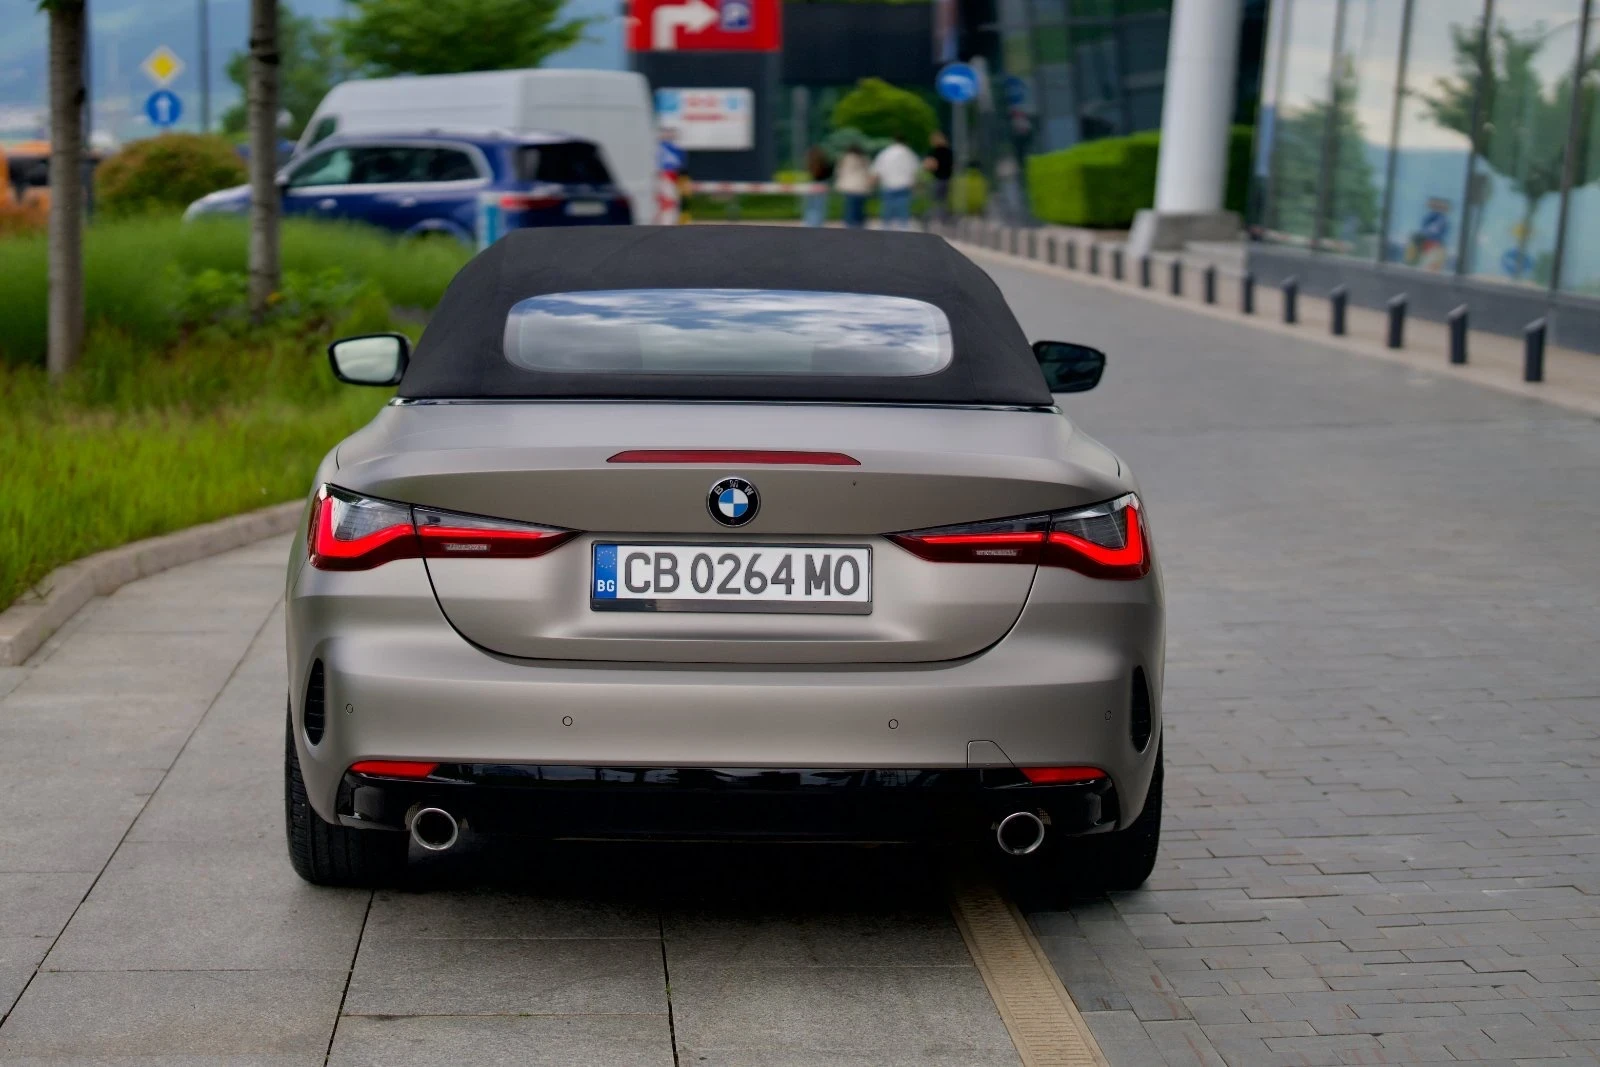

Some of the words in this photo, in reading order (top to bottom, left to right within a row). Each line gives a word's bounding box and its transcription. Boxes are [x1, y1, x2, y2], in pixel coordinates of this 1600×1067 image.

[714, 479, 754, 496] BMW
[624, 551, 680, 594] CB
[690, 552, 795, 596] 0264
[804, 553, 861, 596] MO
[597, 579, 615, 592] BG
